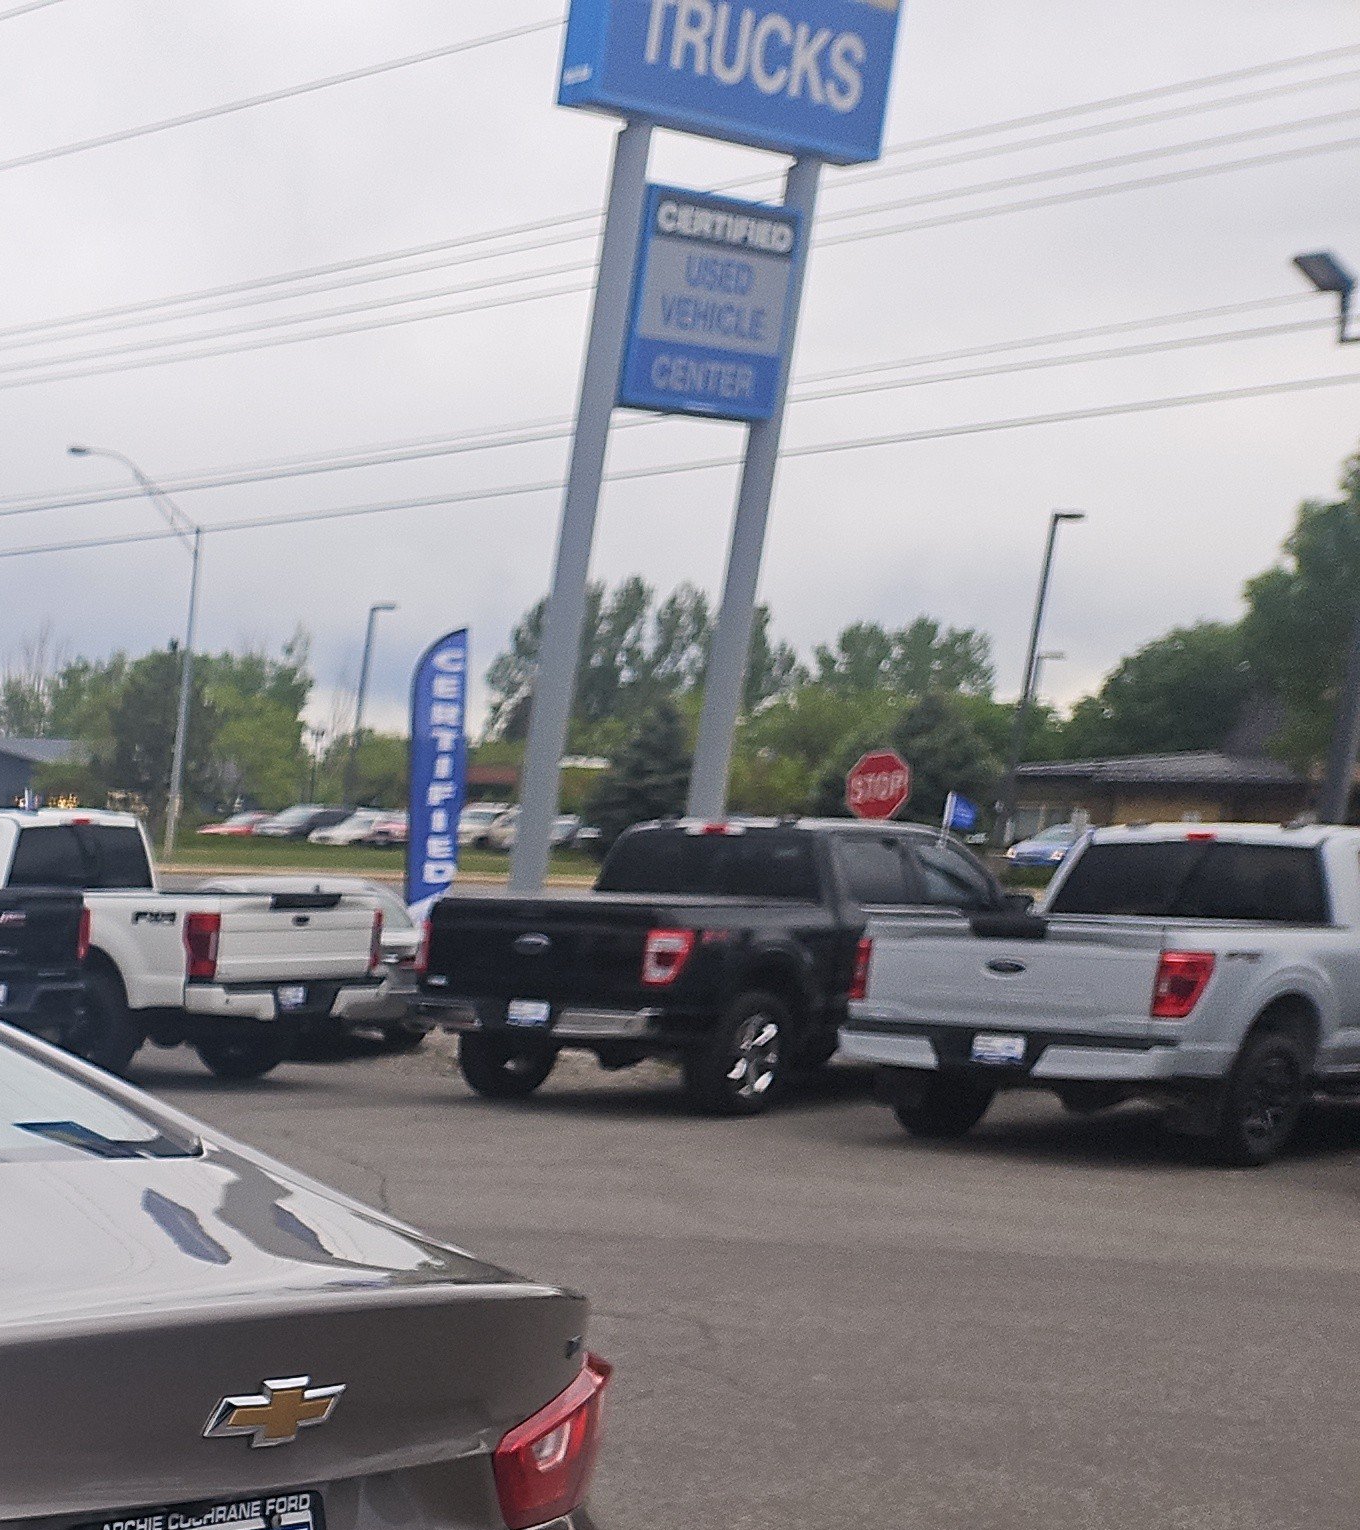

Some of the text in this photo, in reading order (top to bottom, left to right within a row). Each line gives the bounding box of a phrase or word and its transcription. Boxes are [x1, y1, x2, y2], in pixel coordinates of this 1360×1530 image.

[644, 0, 867, 112] TRUCKS
[656, 200, 795, 254] CERTIFIED
[684, 254, 755, 295] USED
[660, 294, 767, 342] VEHICLE
[651, 355, 754, 399] CENTER
[422, 648, 466, 884] CERTIFIED
[851, 770, 908, 804] STOP
[266, 1493, 310, 1515] FORD
